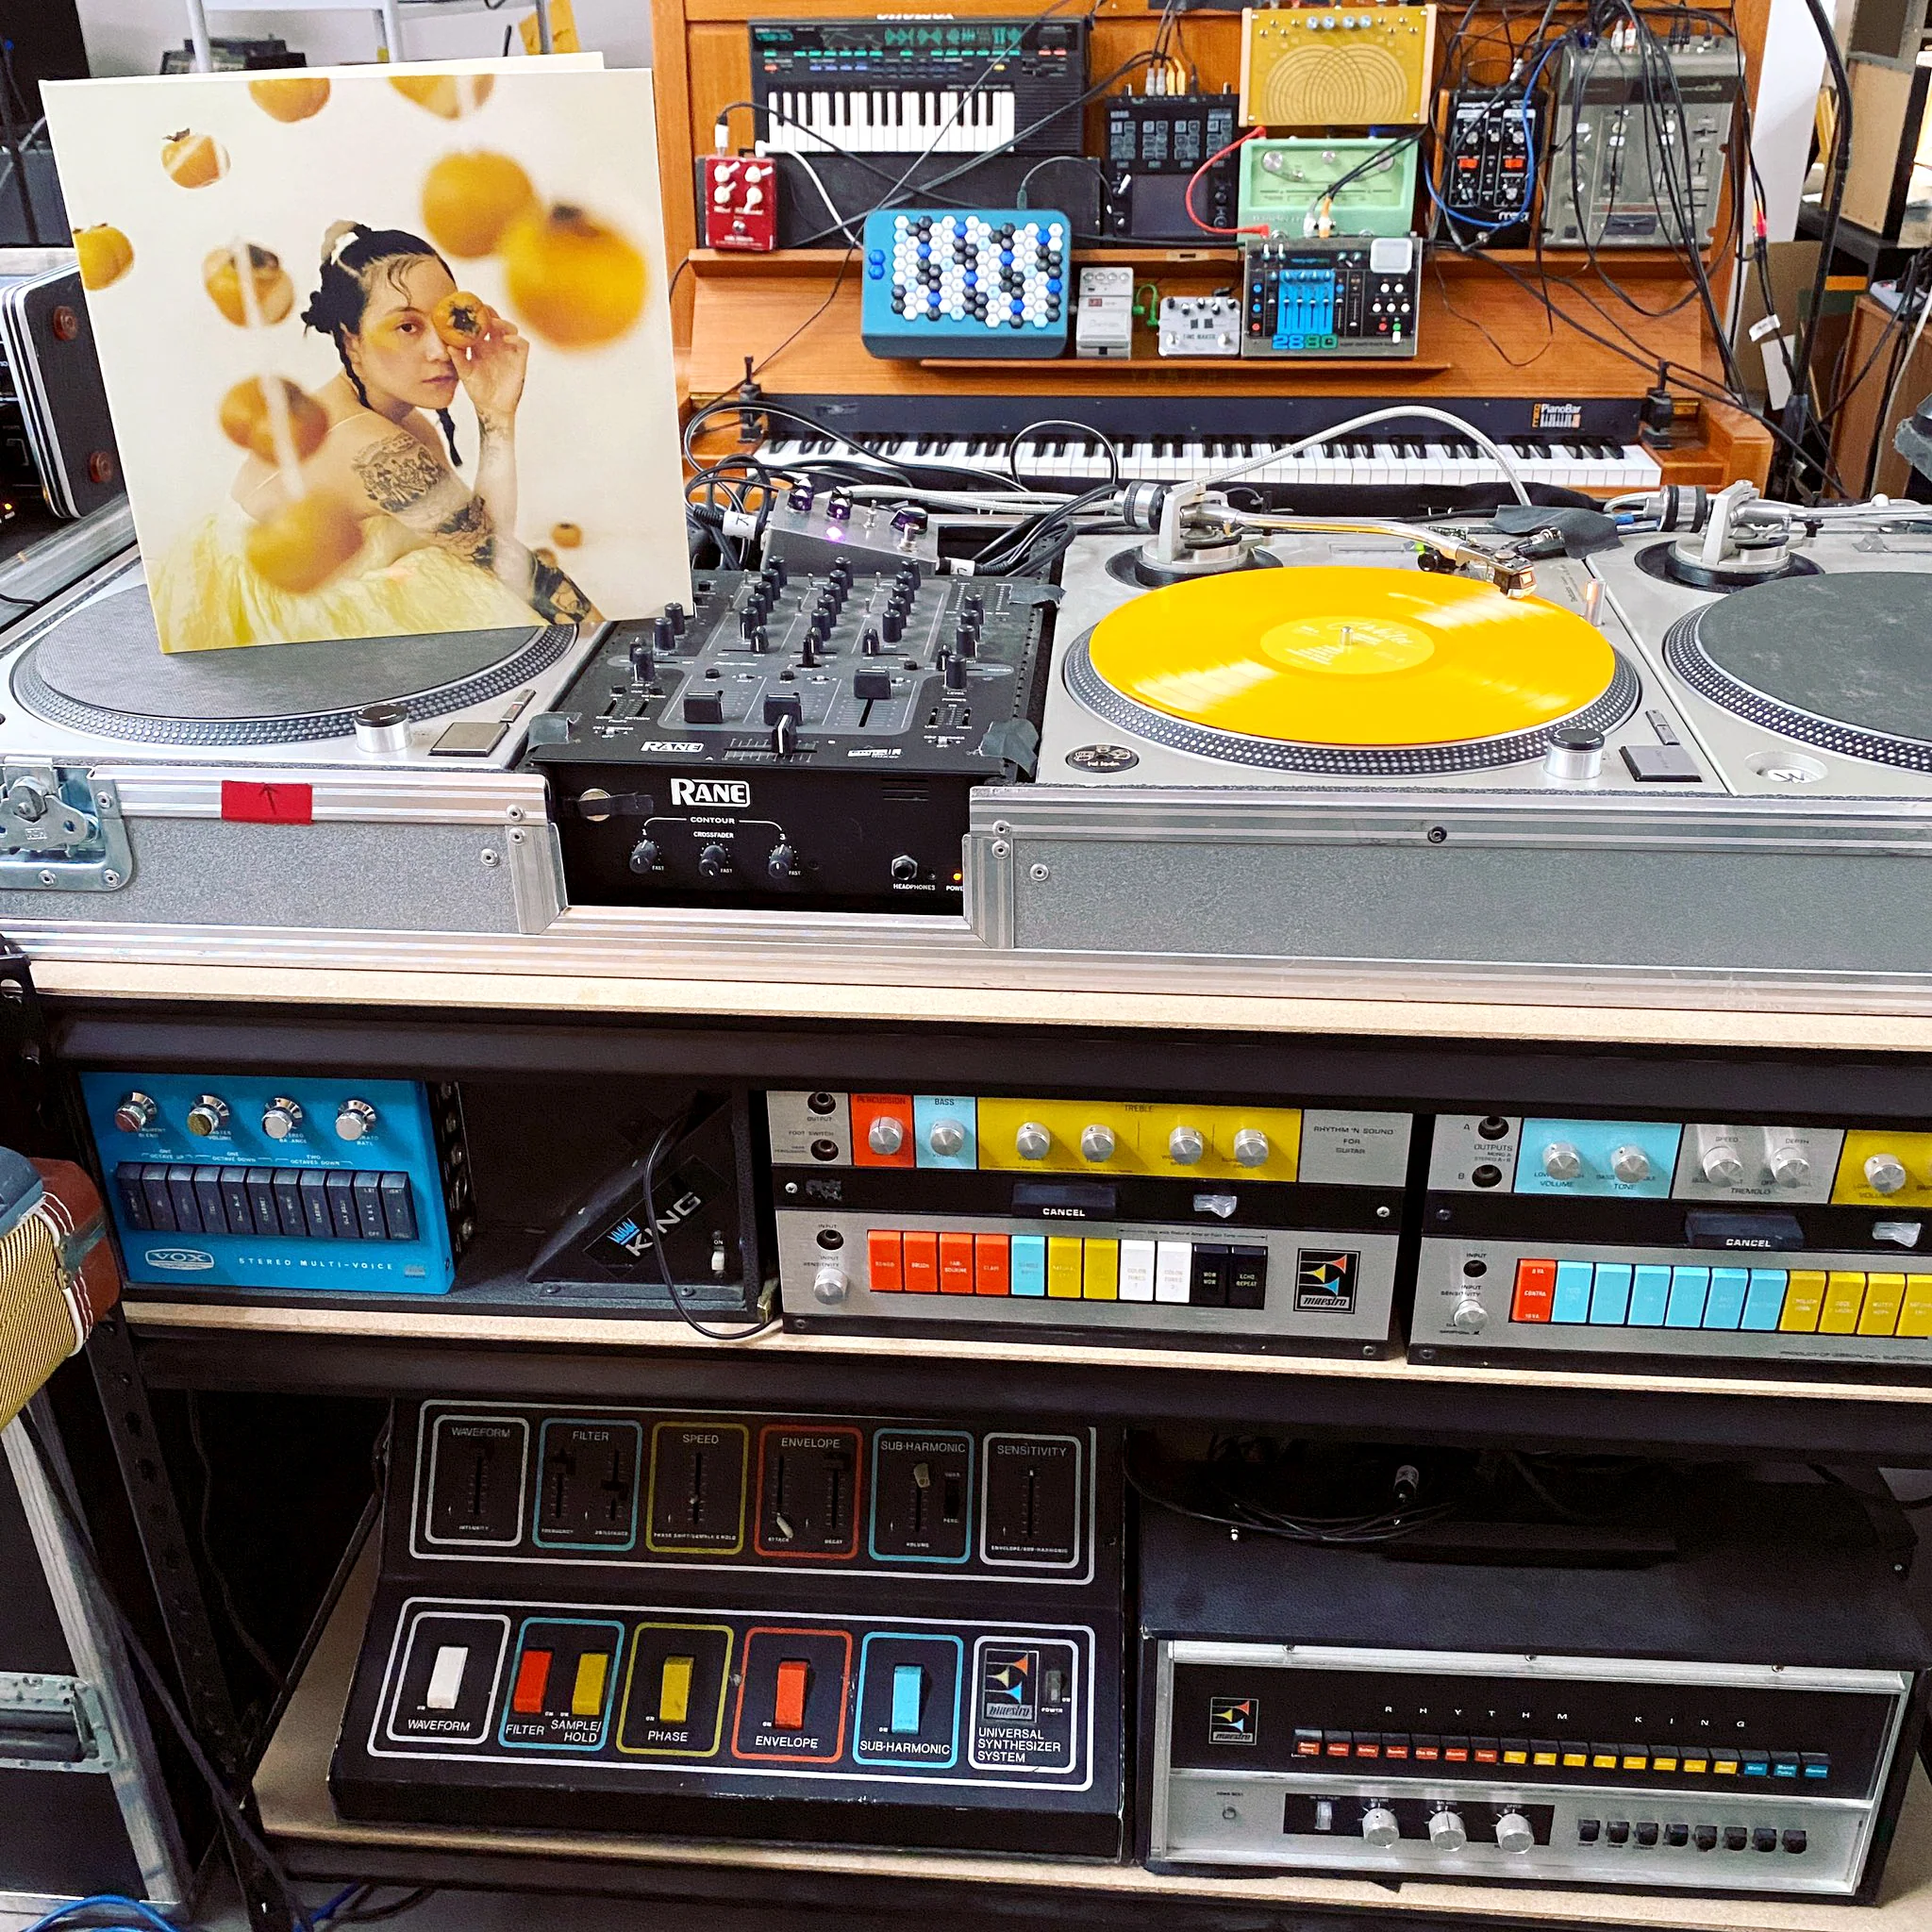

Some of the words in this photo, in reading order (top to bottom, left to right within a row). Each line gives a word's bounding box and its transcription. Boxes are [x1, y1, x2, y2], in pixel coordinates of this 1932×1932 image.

[1272, 334, 1339, 350] 2880
[1541, 404, 1582, 413] PianoBar
[641, 741, 705, 753] RANE
[671, 778, 749, 808] RANE
[857, 1095, 907, 1106] PERCUSSION
[1124, 1104, 1156, 1113] TREBLE
[1474, 1143, 1513, 1153] OUTPUTS
[1042, 1208, 1086, 1217] CANCEL
[1725, 1239, 1772, 1248] CANCEL
[153, 1252, 207, 1262] VOX
[239, 1257, 291, 1266] STEREO
[300, 1259, 393, 1271] MULTI-VOICE
[1303, 1296, 1348, 1307] maestro
[452, 1426, 510, 1439] WAVEFORM
[573, 1431, 609, 1441] FILTER
[682, 1434, 719, 1445] SPEED
[781, 1438, 841, 1449] ENVELOPE
[880, 1441, 966, 1454] SUB-HARMONIC
[997, 1444, 1067, 1457] SENSITIVITY
[1385, 1706, 1569, 1720] RHYTHM
[1635, 1716, 1746, 1728] KING
[408, 1719, 471, 1732] WAVEFORM
[505, 1724, 545, 1737] FILTER
[551, 1719, 603, 1732] SAMPLE/
[563, 1731, 597, 1744] HOLD
[647, 1730, 689, 1742] PHASE
[978, 1726, 1045, 1740] UNIVERSAL
[754, 1735, 819, 1750] ENVELOPE
[858, 1740, 951, 1755] SUB-HARMONIC
[977, 1739, 1061, 1753] SYNTHESIZER
[977, 1750, 1025, 1763] SYSTEM
